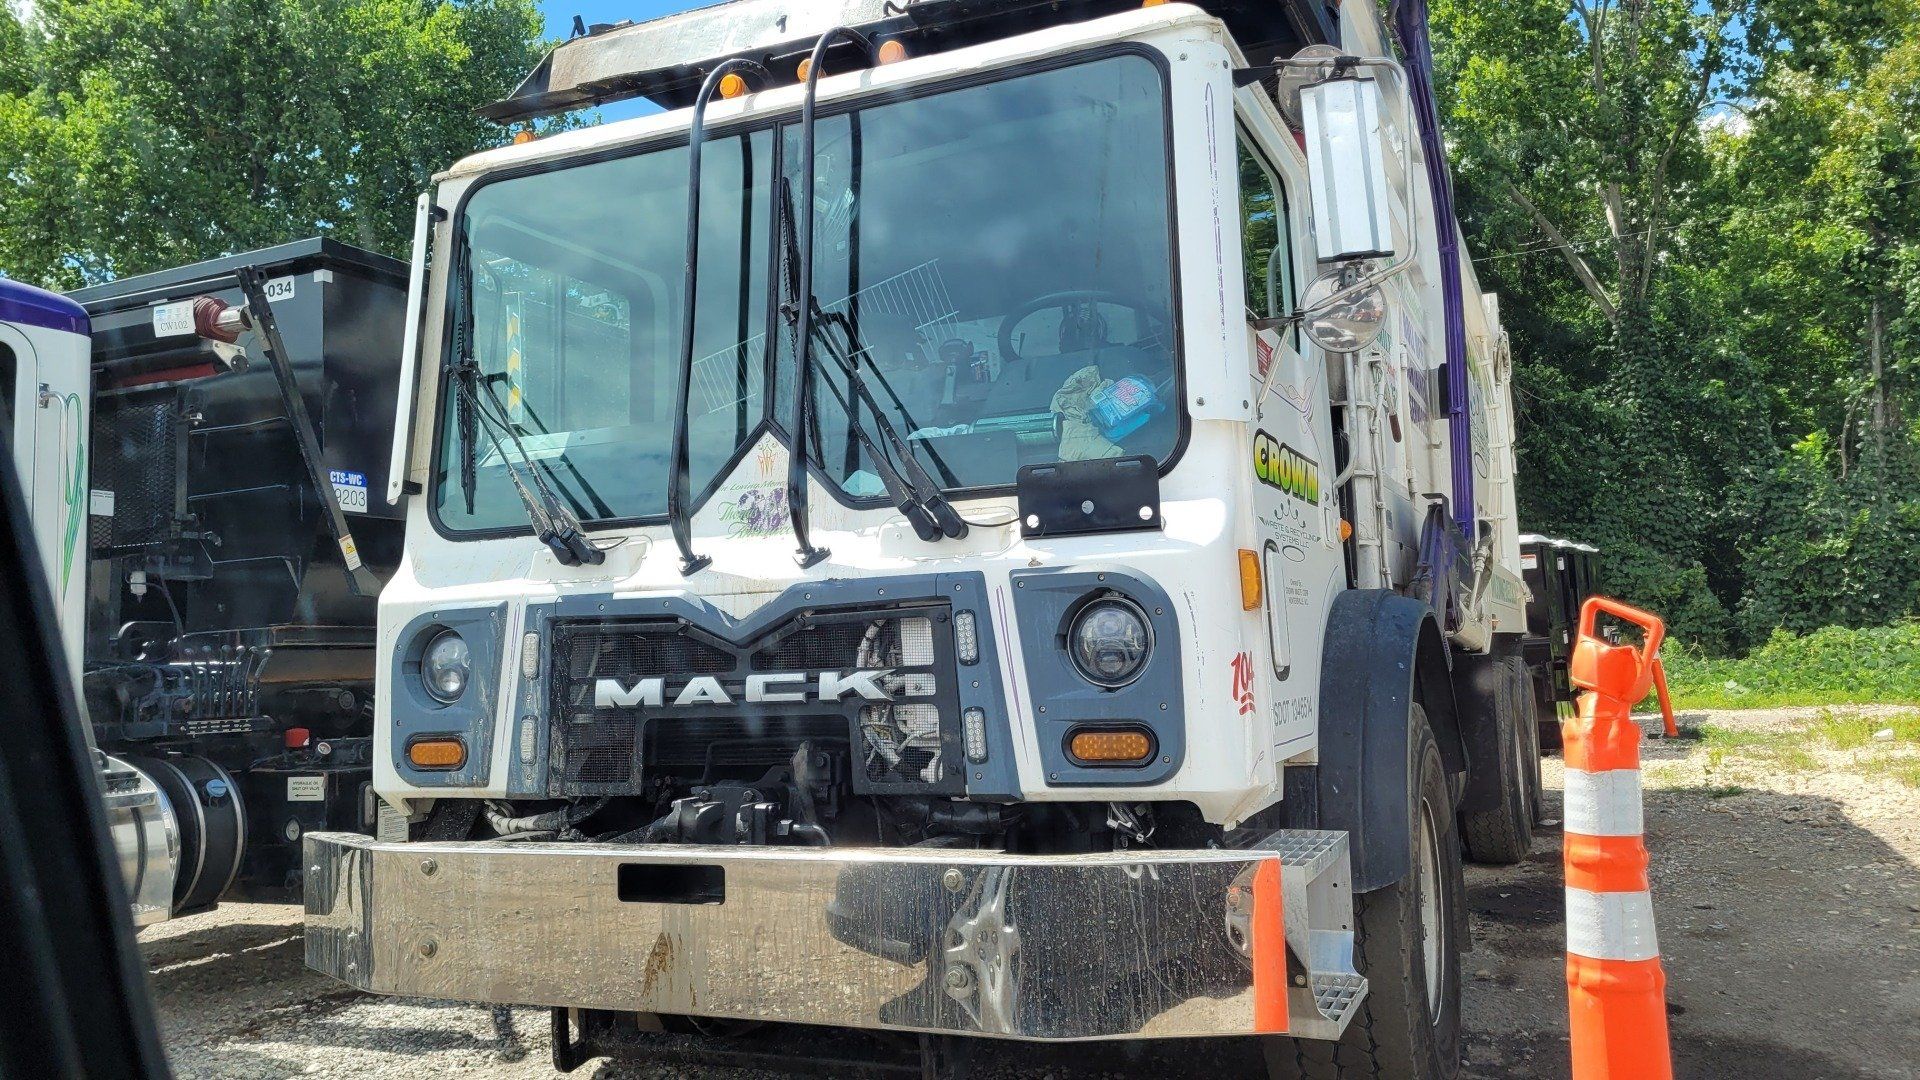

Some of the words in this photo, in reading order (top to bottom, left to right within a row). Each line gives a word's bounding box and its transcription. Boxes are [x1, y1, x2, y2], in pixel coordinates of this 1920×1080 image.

[160, 320, 189, 332] CW102
[330, 470, 363, 486] CTS-WC
[1253, 428, 1318, 507] CROWN
[594, 668, 897, 709] MACK
[1230, 650, 1254, 702] 104
